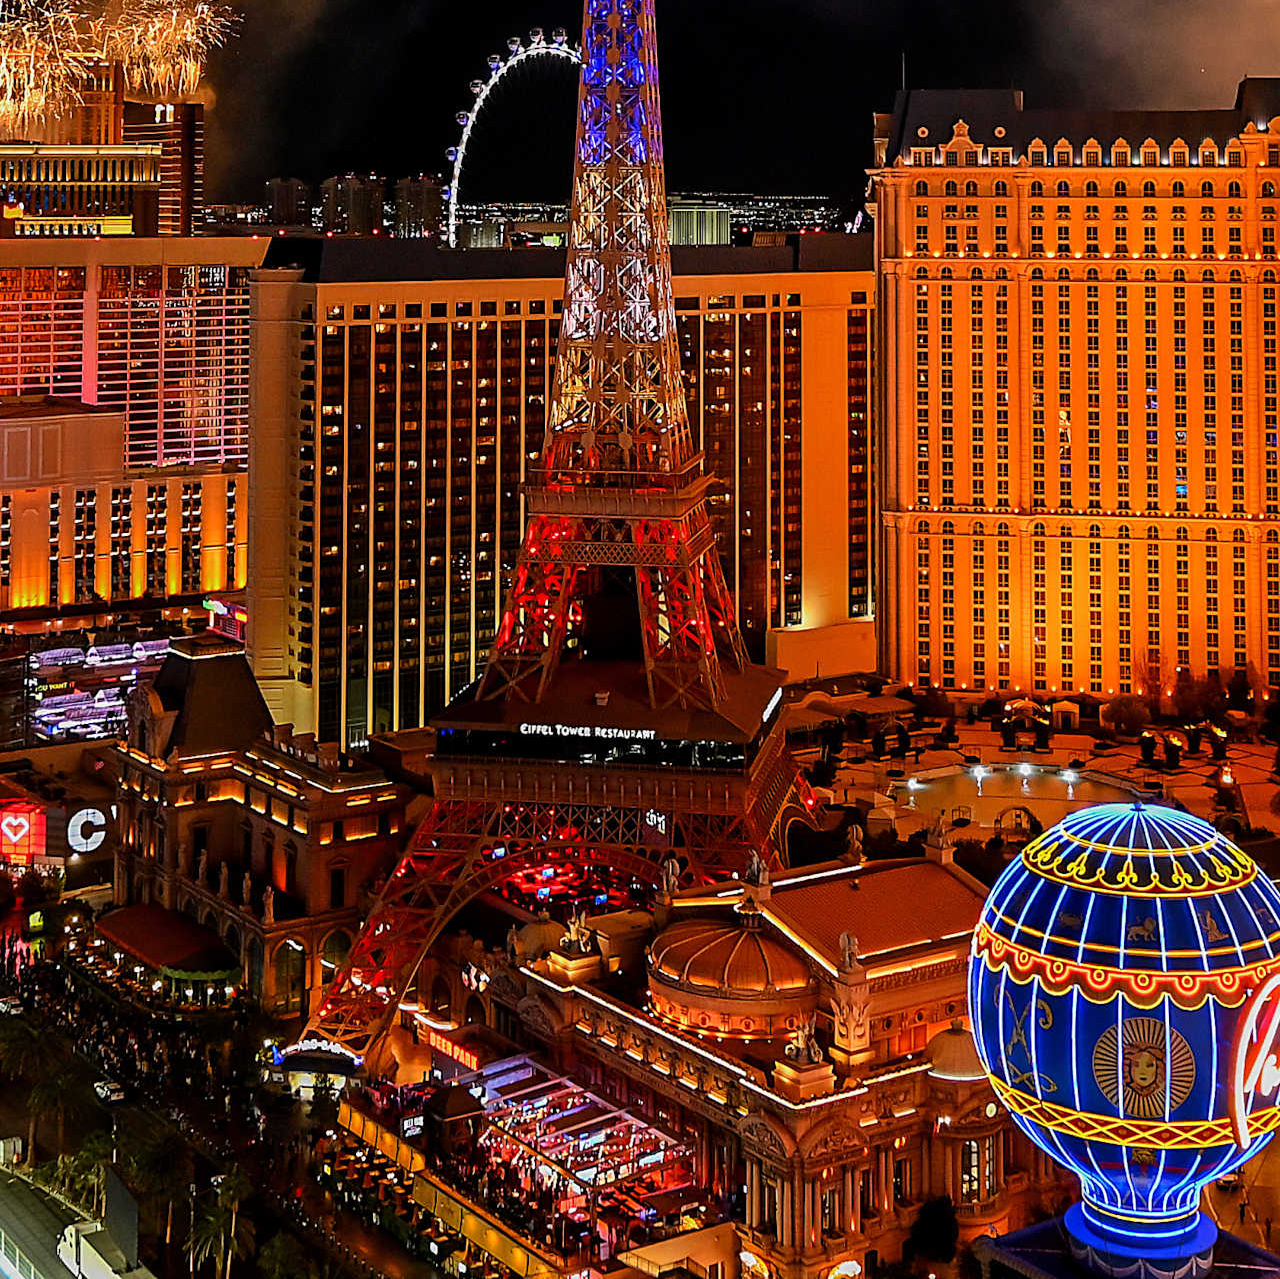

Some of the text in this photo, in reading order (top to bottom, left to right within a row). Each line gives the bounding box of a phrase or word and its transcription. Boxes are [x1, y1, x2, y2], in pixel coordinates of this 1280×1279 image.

[520, 723, 656, 740] EIFFEL TOWER RESTAURANT
[430, 1031, 478, 1072] BEER PARK
